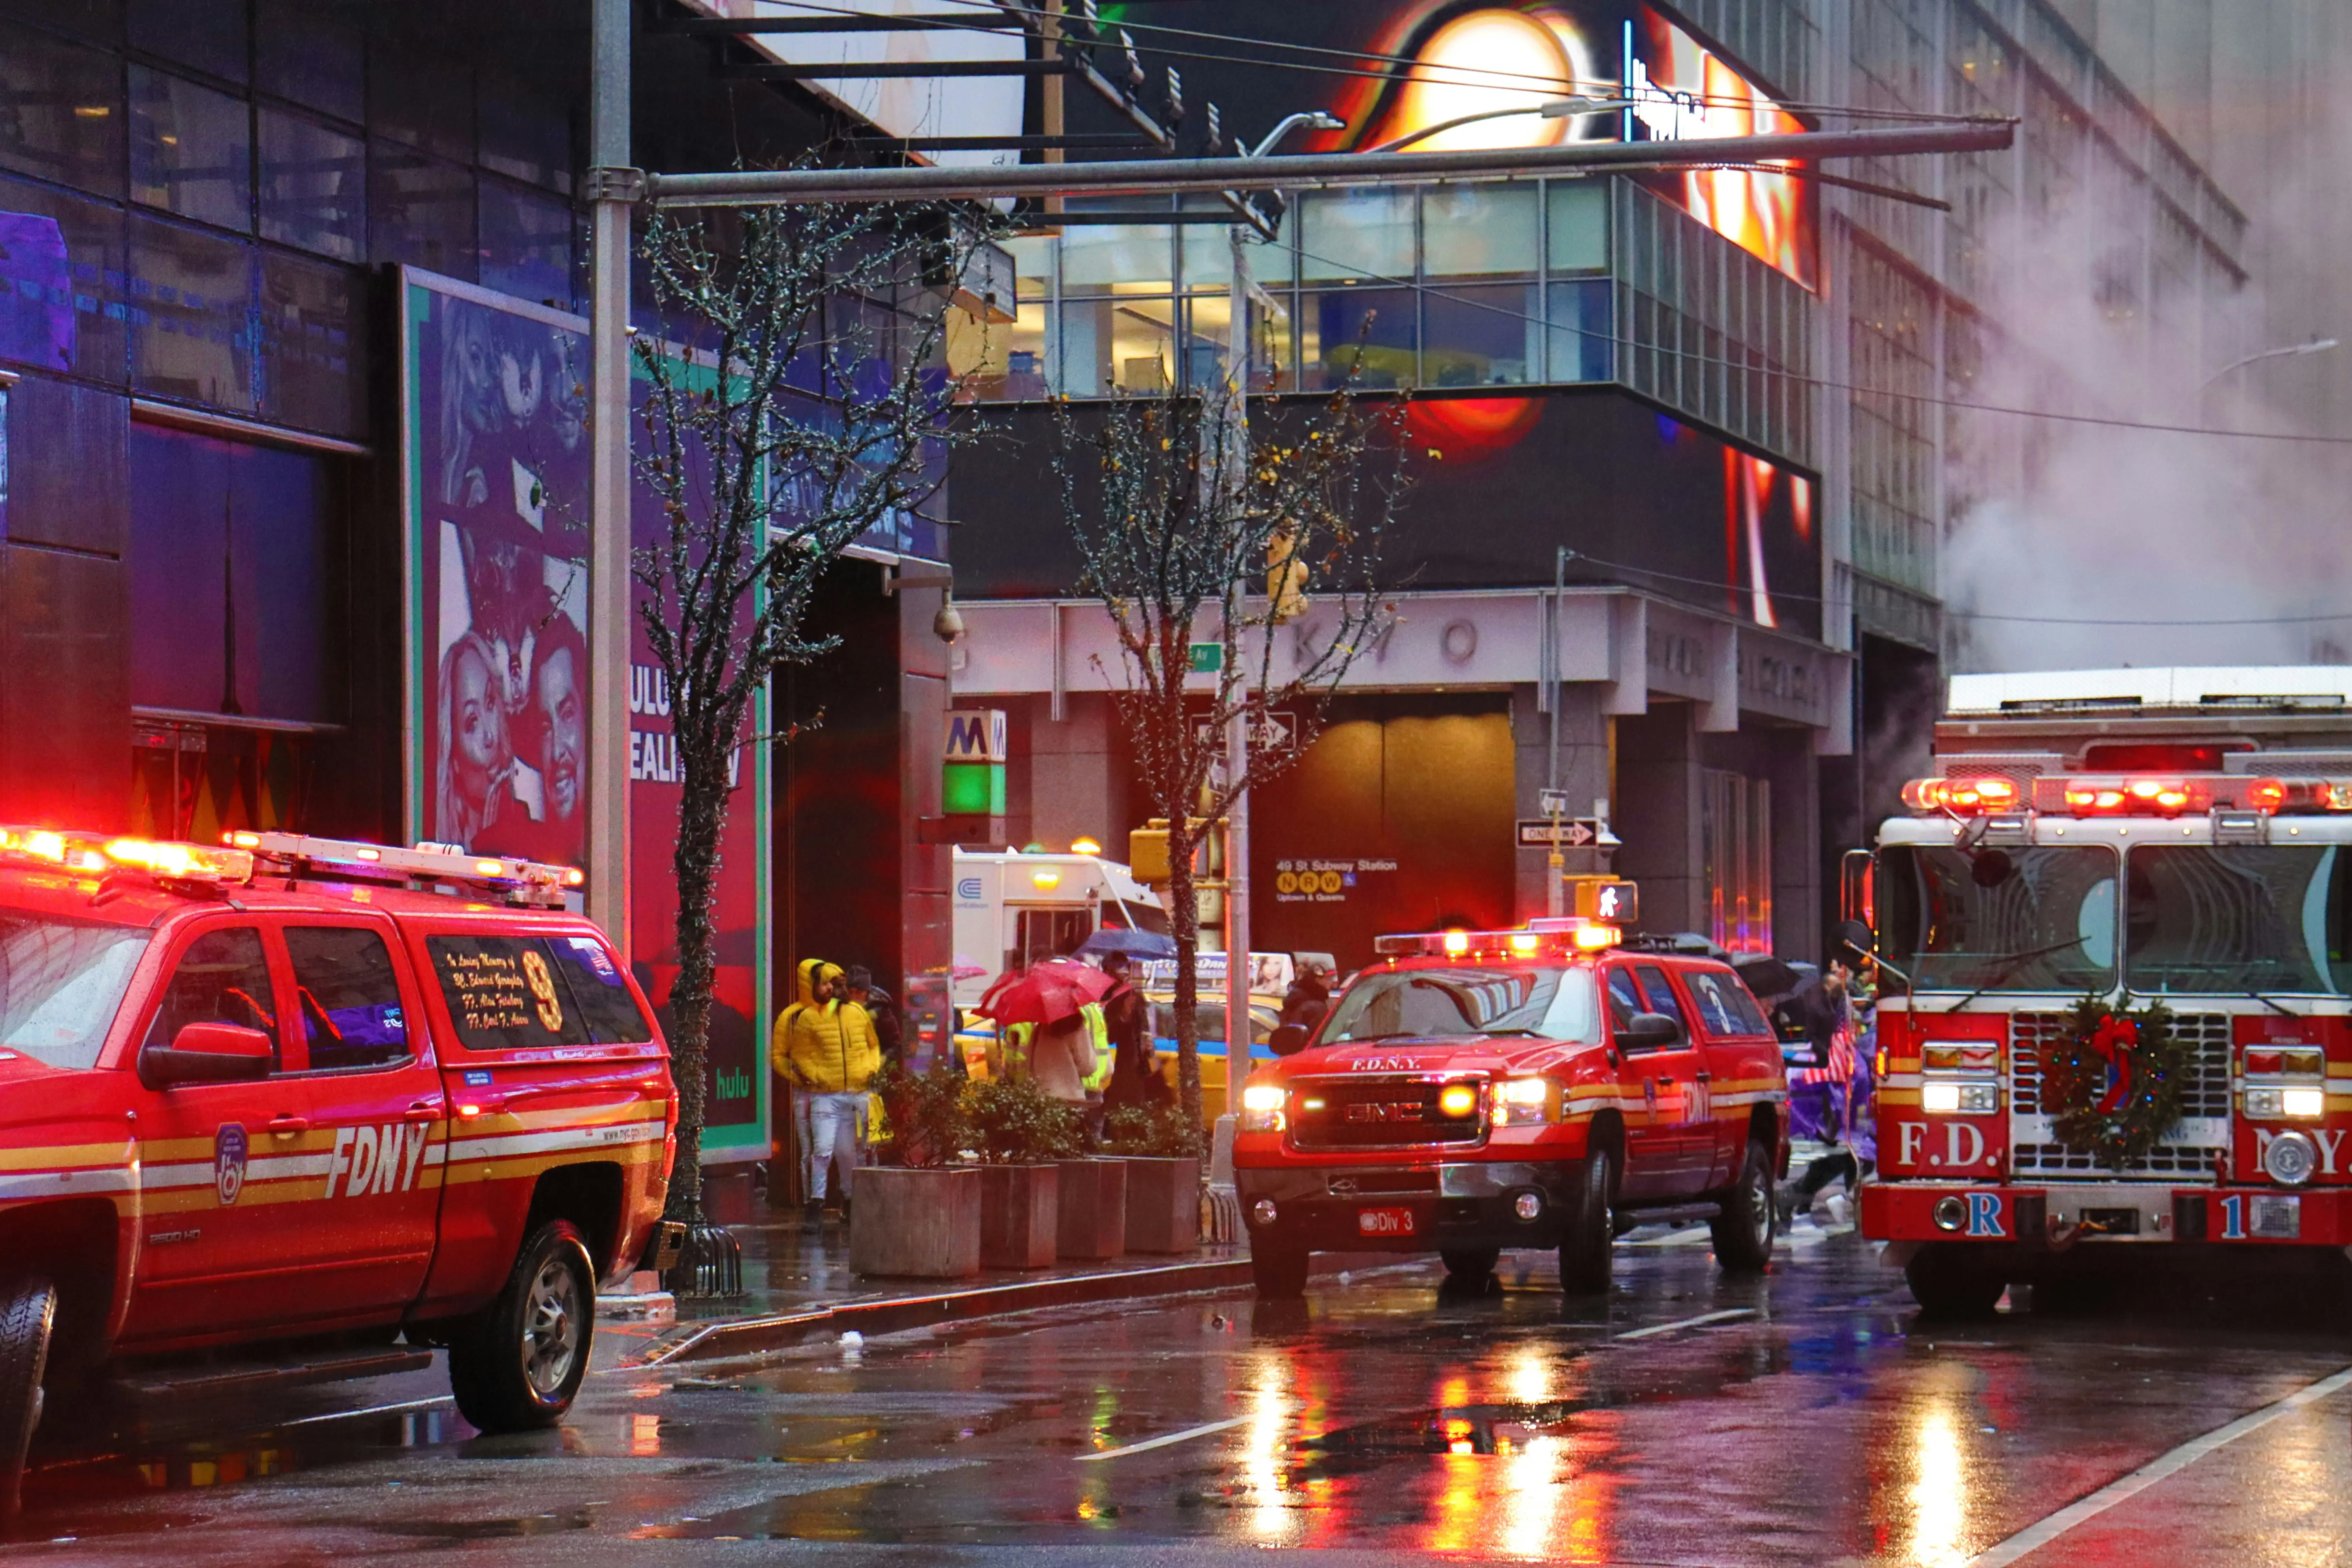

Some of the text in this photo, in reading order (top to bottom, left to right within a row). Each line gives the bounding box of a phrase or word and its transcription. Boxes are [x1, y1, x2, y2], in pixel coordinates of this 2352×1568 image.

[630, 664, 671, 716] ULU
[946, 717, 987, 755] M
[992, 717, 1005, 756] M
[1276, 859, 1397, 873] 49 St Subway Station
[522, 948, 563, 1033] 9
[716, 1066, 749, 1100] hulu
[1352, 1058, 1421, 1071] F.D.N.Y.
[1345, 1102, 1423, 1122] GMC
[325, 1122, 430, 1199] FDNY
[1897, 1122, 1997, 1167] F.D.
[1377, 1210, 1414, 1231] Div 3
[1964, 1192, 2006, 1237] R
[2220, 1194, 2247, 1239] 1
